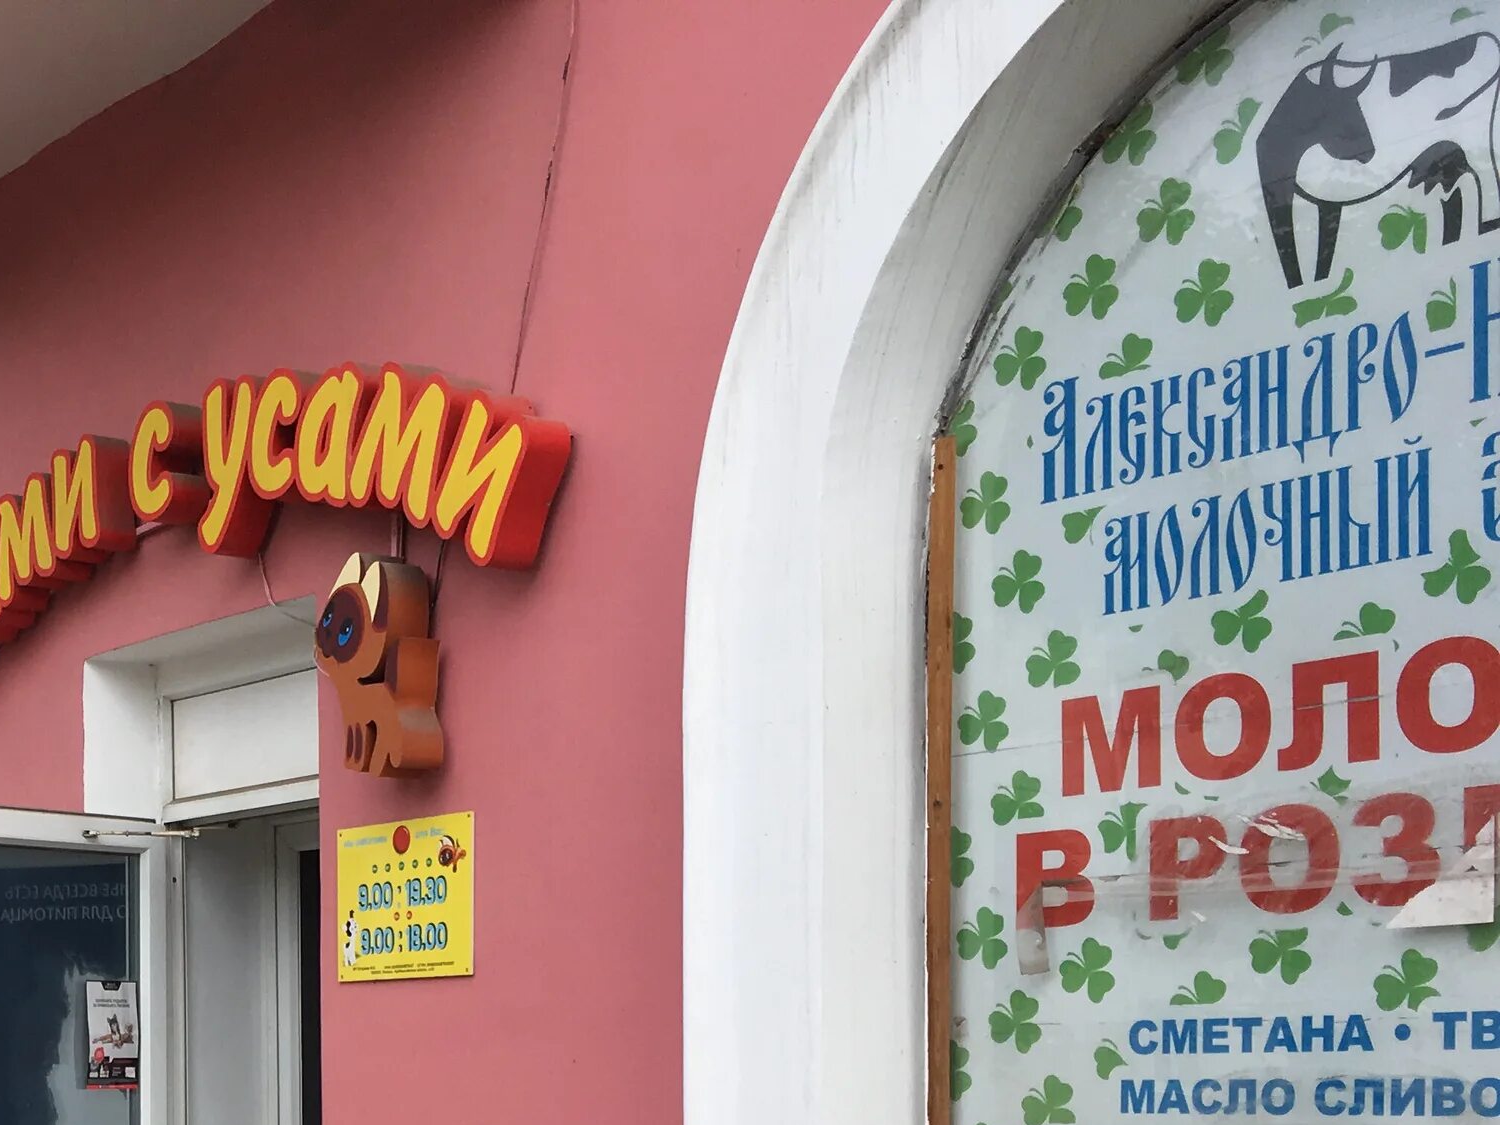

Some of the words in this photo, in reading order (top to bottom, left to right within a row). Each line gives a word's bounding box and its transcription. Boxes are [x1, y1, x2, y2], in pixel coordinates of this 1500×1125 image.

[1102, 435, 1433, 616] МОЛОЧНЫЙ
[1061, 636, 1500, 798] МОЛО
[1015, 828, 1096, 929] В
[1128, 1013, 1375, 1056] СМЕТАНА
[1431, 1010, 1500, 1050] ТВ
[1119, 1077, 1295, 1116] МАСЛО
[1313, 1077, 1500, 1117] СЛИВО
